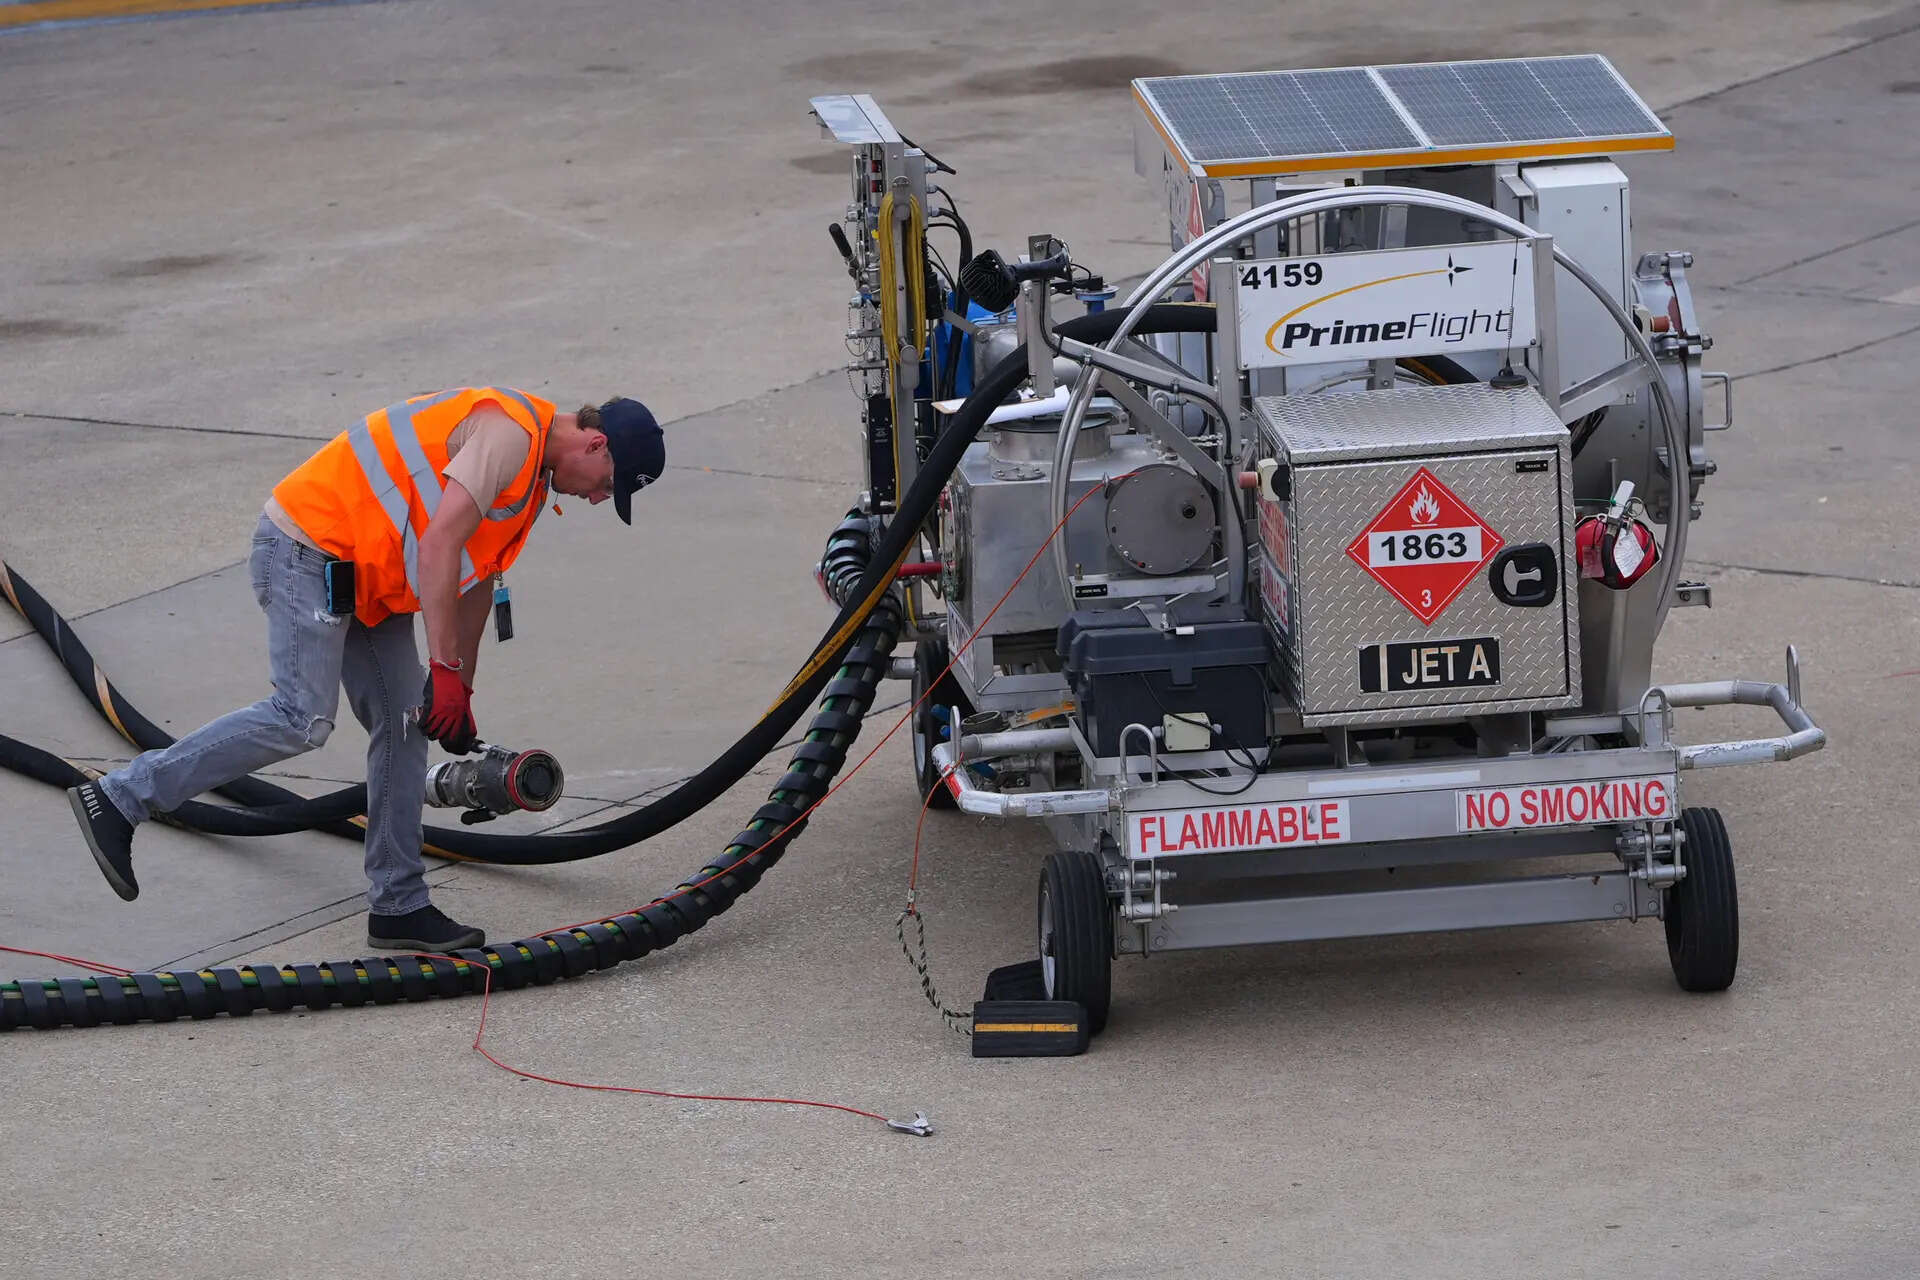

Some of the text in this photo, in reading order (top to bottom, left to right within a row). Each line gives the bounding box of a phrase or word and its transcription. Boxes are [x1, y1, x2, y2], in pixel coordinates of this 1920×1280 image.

[1241, 261, 1323, 290] 4159
[1282, 309, 1511, 348] PrimeFlight
[1381, 532, 1467, 561] 1863
[1421, 589, 1432, 608] 3
[1402, 643, 1492, 684] JET A
[1466, 780, 1666, 830] NO SMOKING
[1139, 803, 1340, 853] FLAMMABLE
